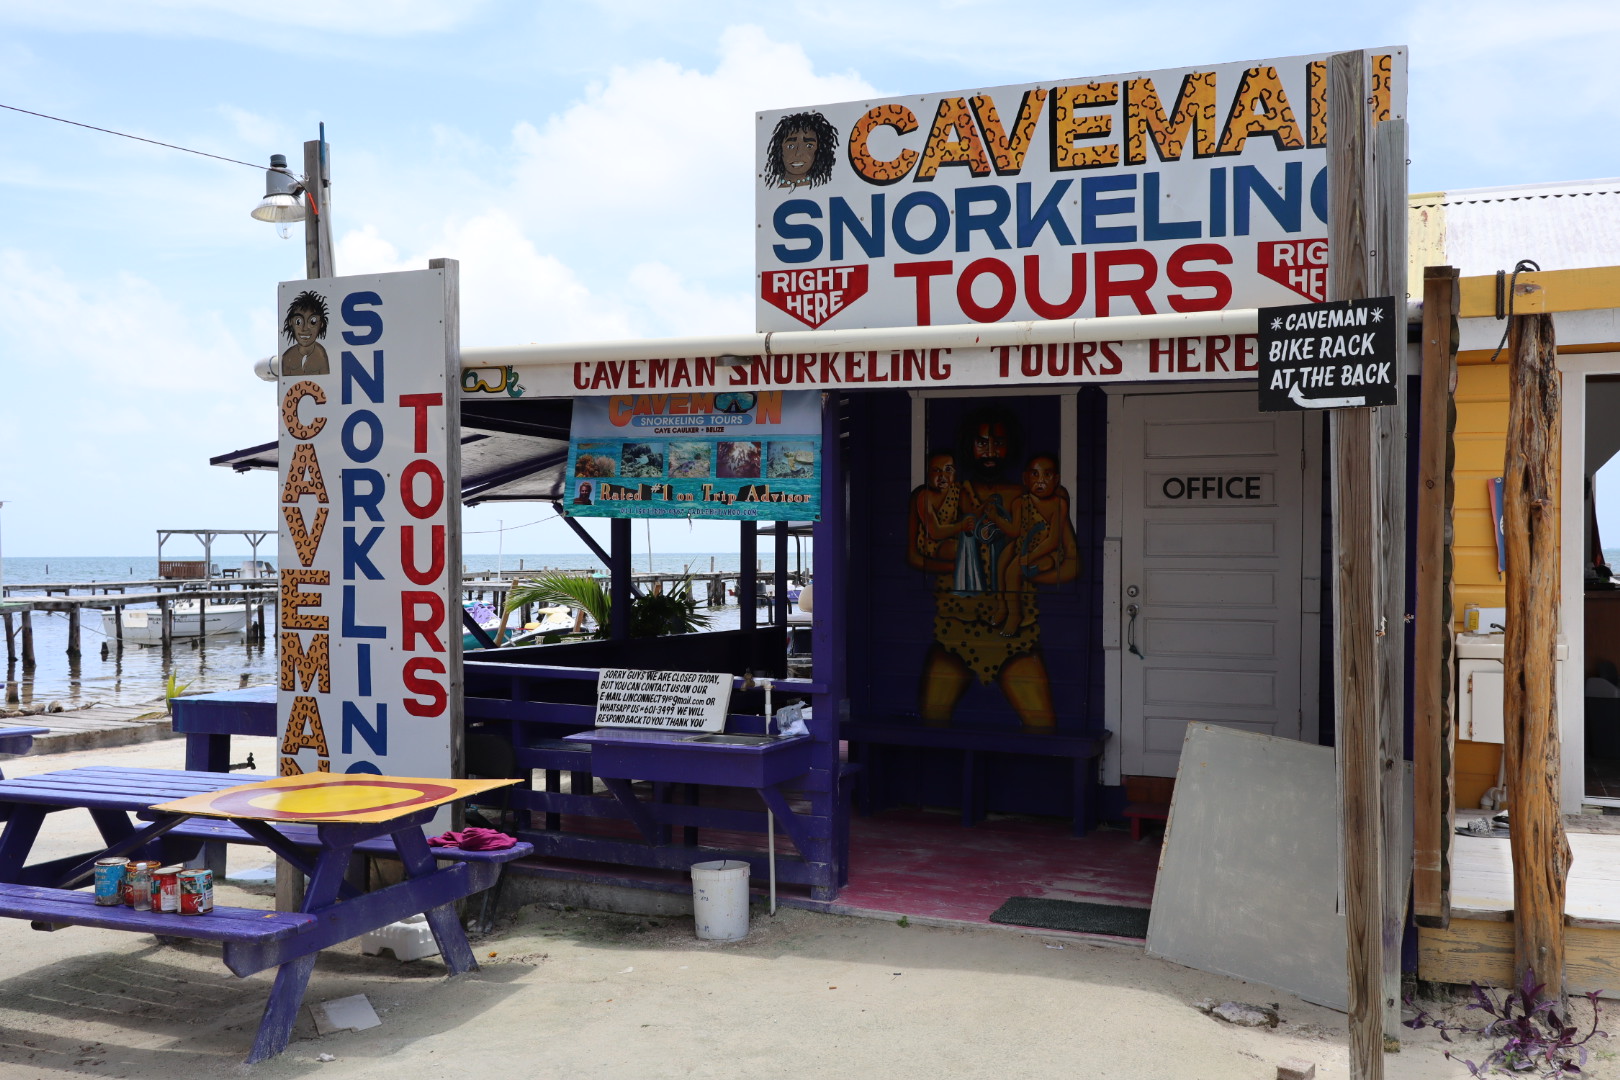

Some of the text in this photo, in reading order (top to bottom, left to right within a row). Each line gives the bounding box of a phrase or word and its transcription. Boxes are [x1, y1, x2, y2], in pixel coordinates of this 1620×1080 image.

[771, 160, 1328, 264] SNORKELIN
[1273, 240, 1328, 268] RIG
[772, 267, 855, 294] RIGHT
[894, 243, 1234, 327] TOURS
[1288, 267, 1327, 302] HE
[786, 290, 844, 325] HERE
[1285, 307, 1368, 331] CAVEMAN
[1269, 332, 1376, 362] BIKE RACK
[573, 356, 715, 390] CAVEMAN
[991, 340, 1123, 378] TOURS
[1149, 334, 1258, 373] HERE
[1270, 362, 1391, 390] AT THE BACK
[640, 415, 743, 426] SNORKELING TOURS
[600, 483, 811, 505] Rated #1 on Trip Advisor
[1163, 476, 1261, 499] OFFICE
[341, 290, 388, 776] SNORKLIN
[399, 392, 448, 718] TOURS
[601, 681, 708, 694] BUT YOU CAN CONTACT US ON OUR
[604, 670, 627, 679] SORRY
[646, 671, 658, 681] WE
[657, 672, 672, 682] ARE
[671, 673, 697, 683] CLOSED
[697, 674, 720, 685] TODAY,
[600, 703, 632, 713] WHATSAPP
[631, 705, 640, 713] US
[677, 706, 688, 716] WE
[688, 707, 705, 716] WILL
[705, 697, 716, 706] OR
[597, 714, 625, 724] RESPOND
[625, 715, 642, 725] BACK
[642, 716, 652, 725] TO
